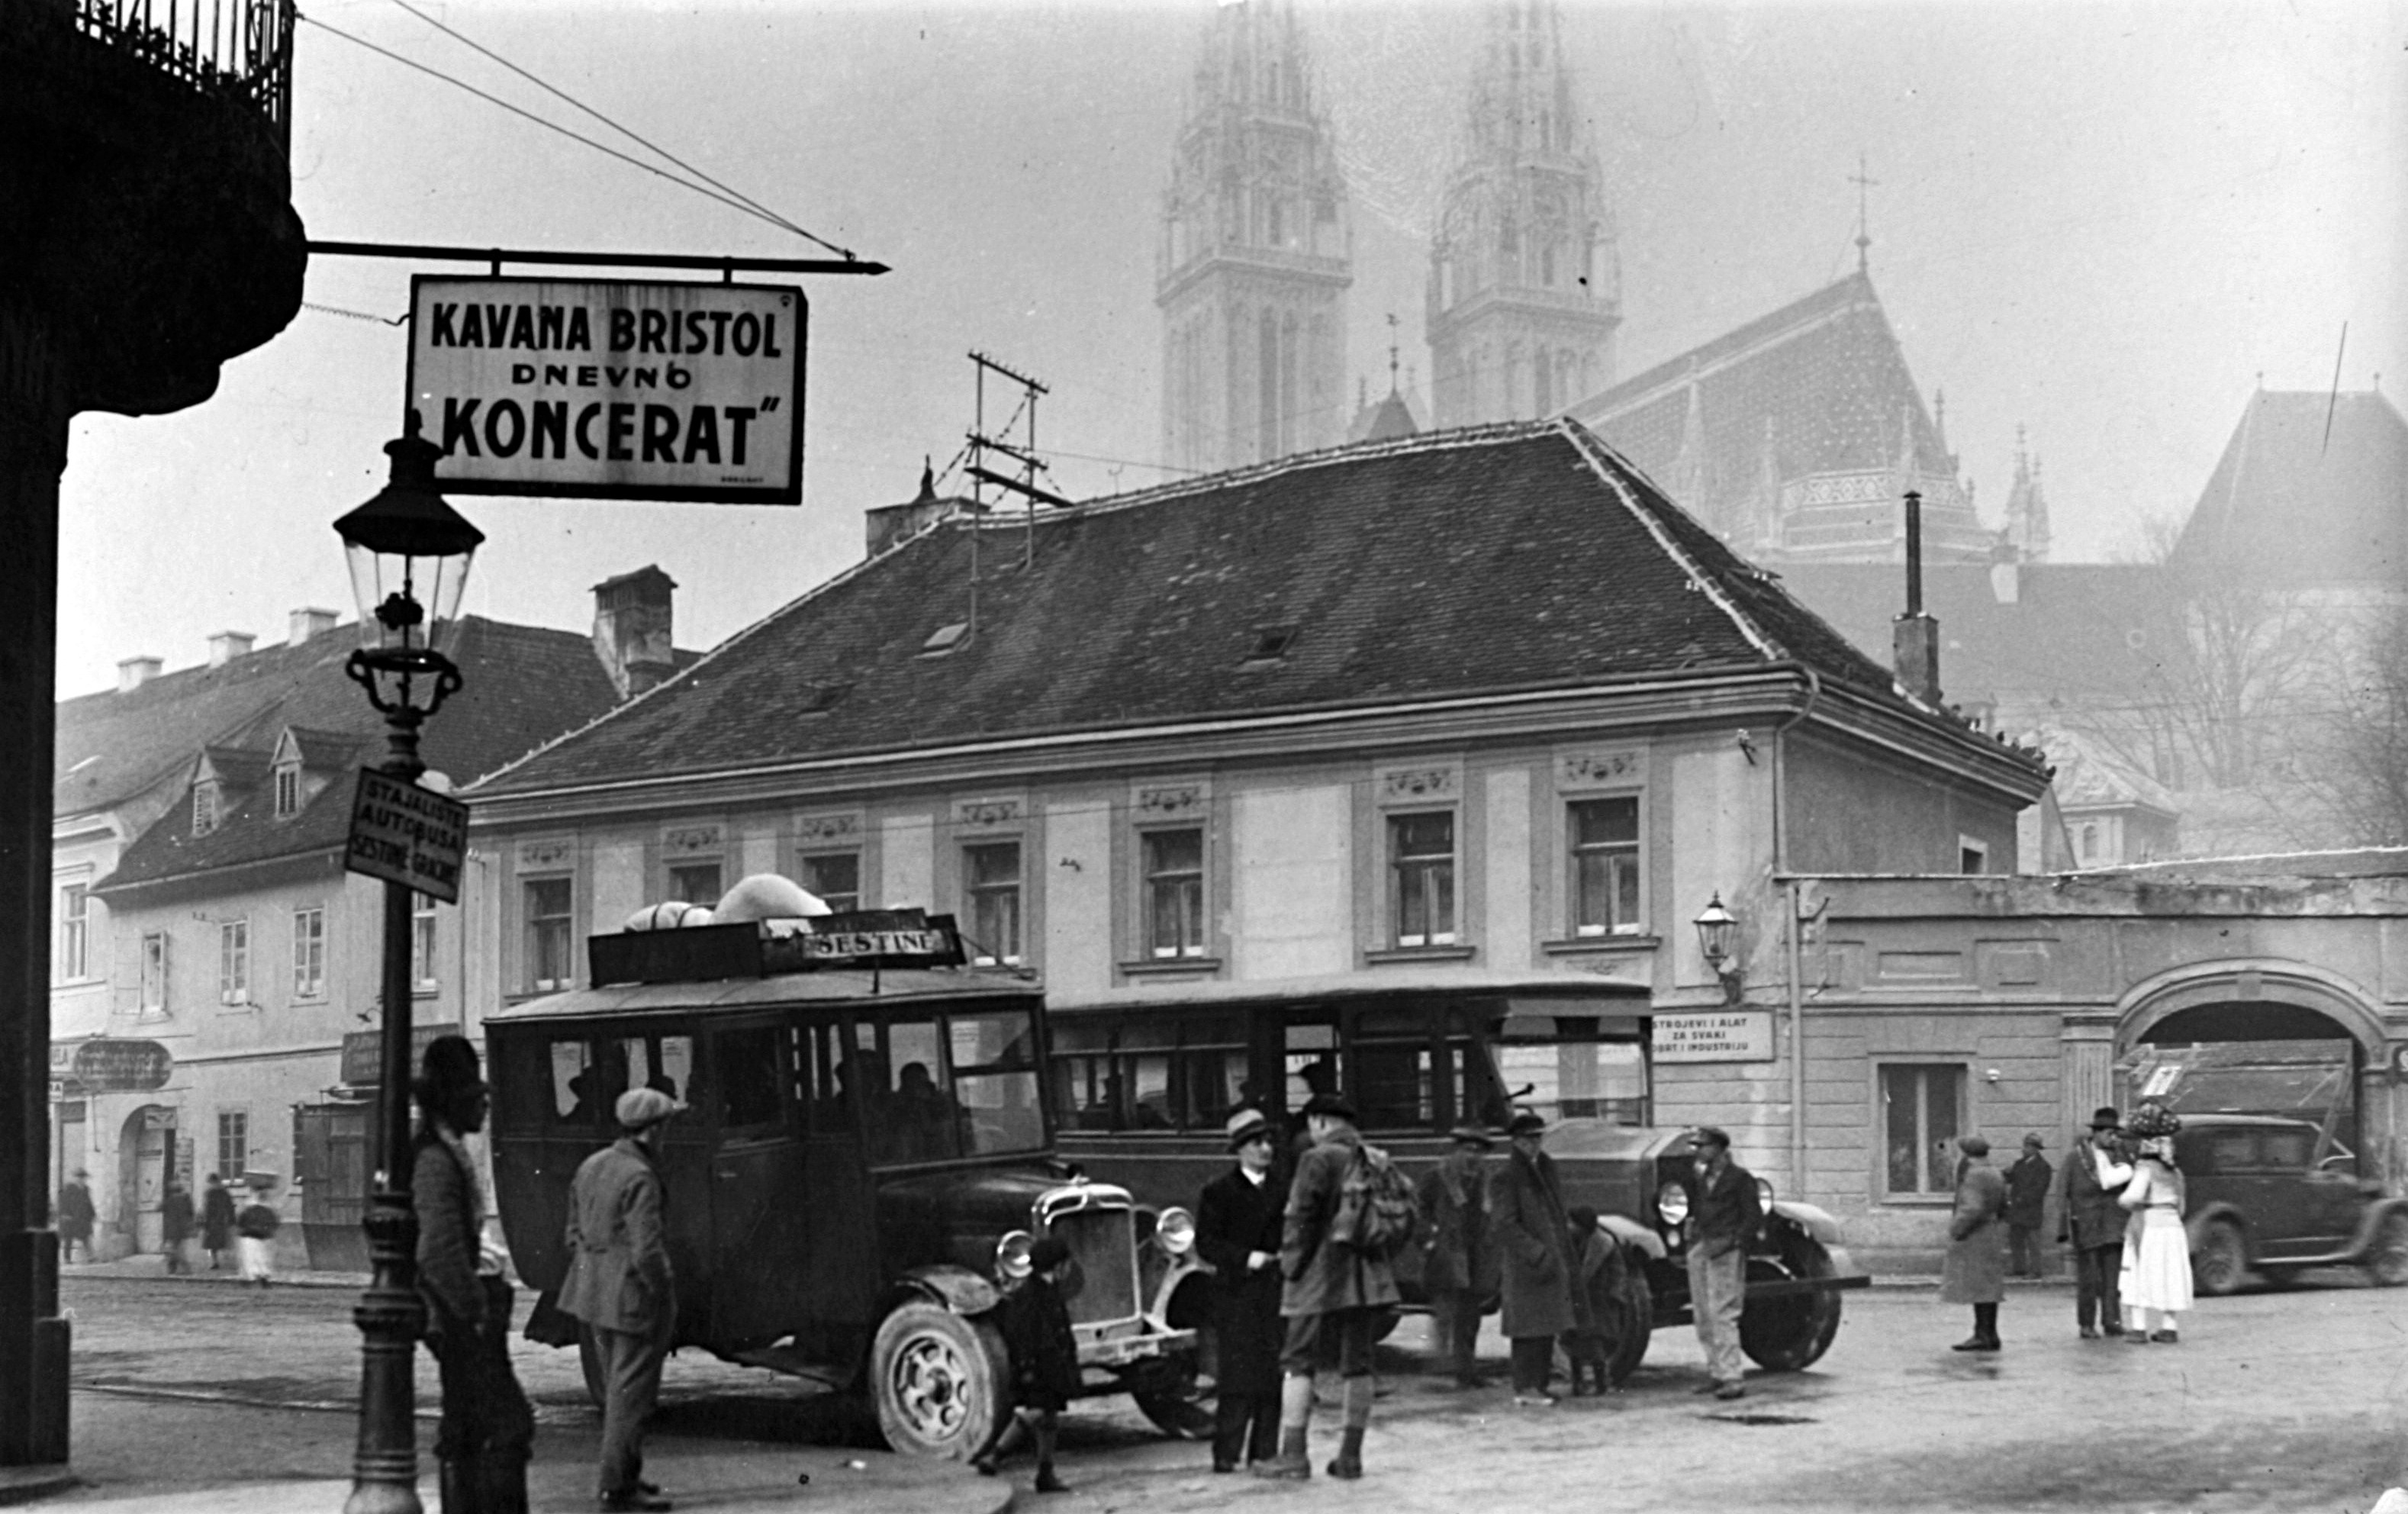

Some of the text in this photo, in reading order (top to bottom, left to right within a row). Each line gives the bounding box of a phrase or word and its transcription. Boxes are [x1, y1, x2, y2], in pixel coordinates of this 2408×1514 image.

[430, 303, 781, 358] KAVANA BRISTOL
[361, 804, 458, 849] AUTOBUSA
[1719, 1018, 1748, 1027] ALAT
[1672, 1031, 1727, 1040] ZA SVAKI
[1687, 1042, 1749, 1052] INDUSTRIJU
